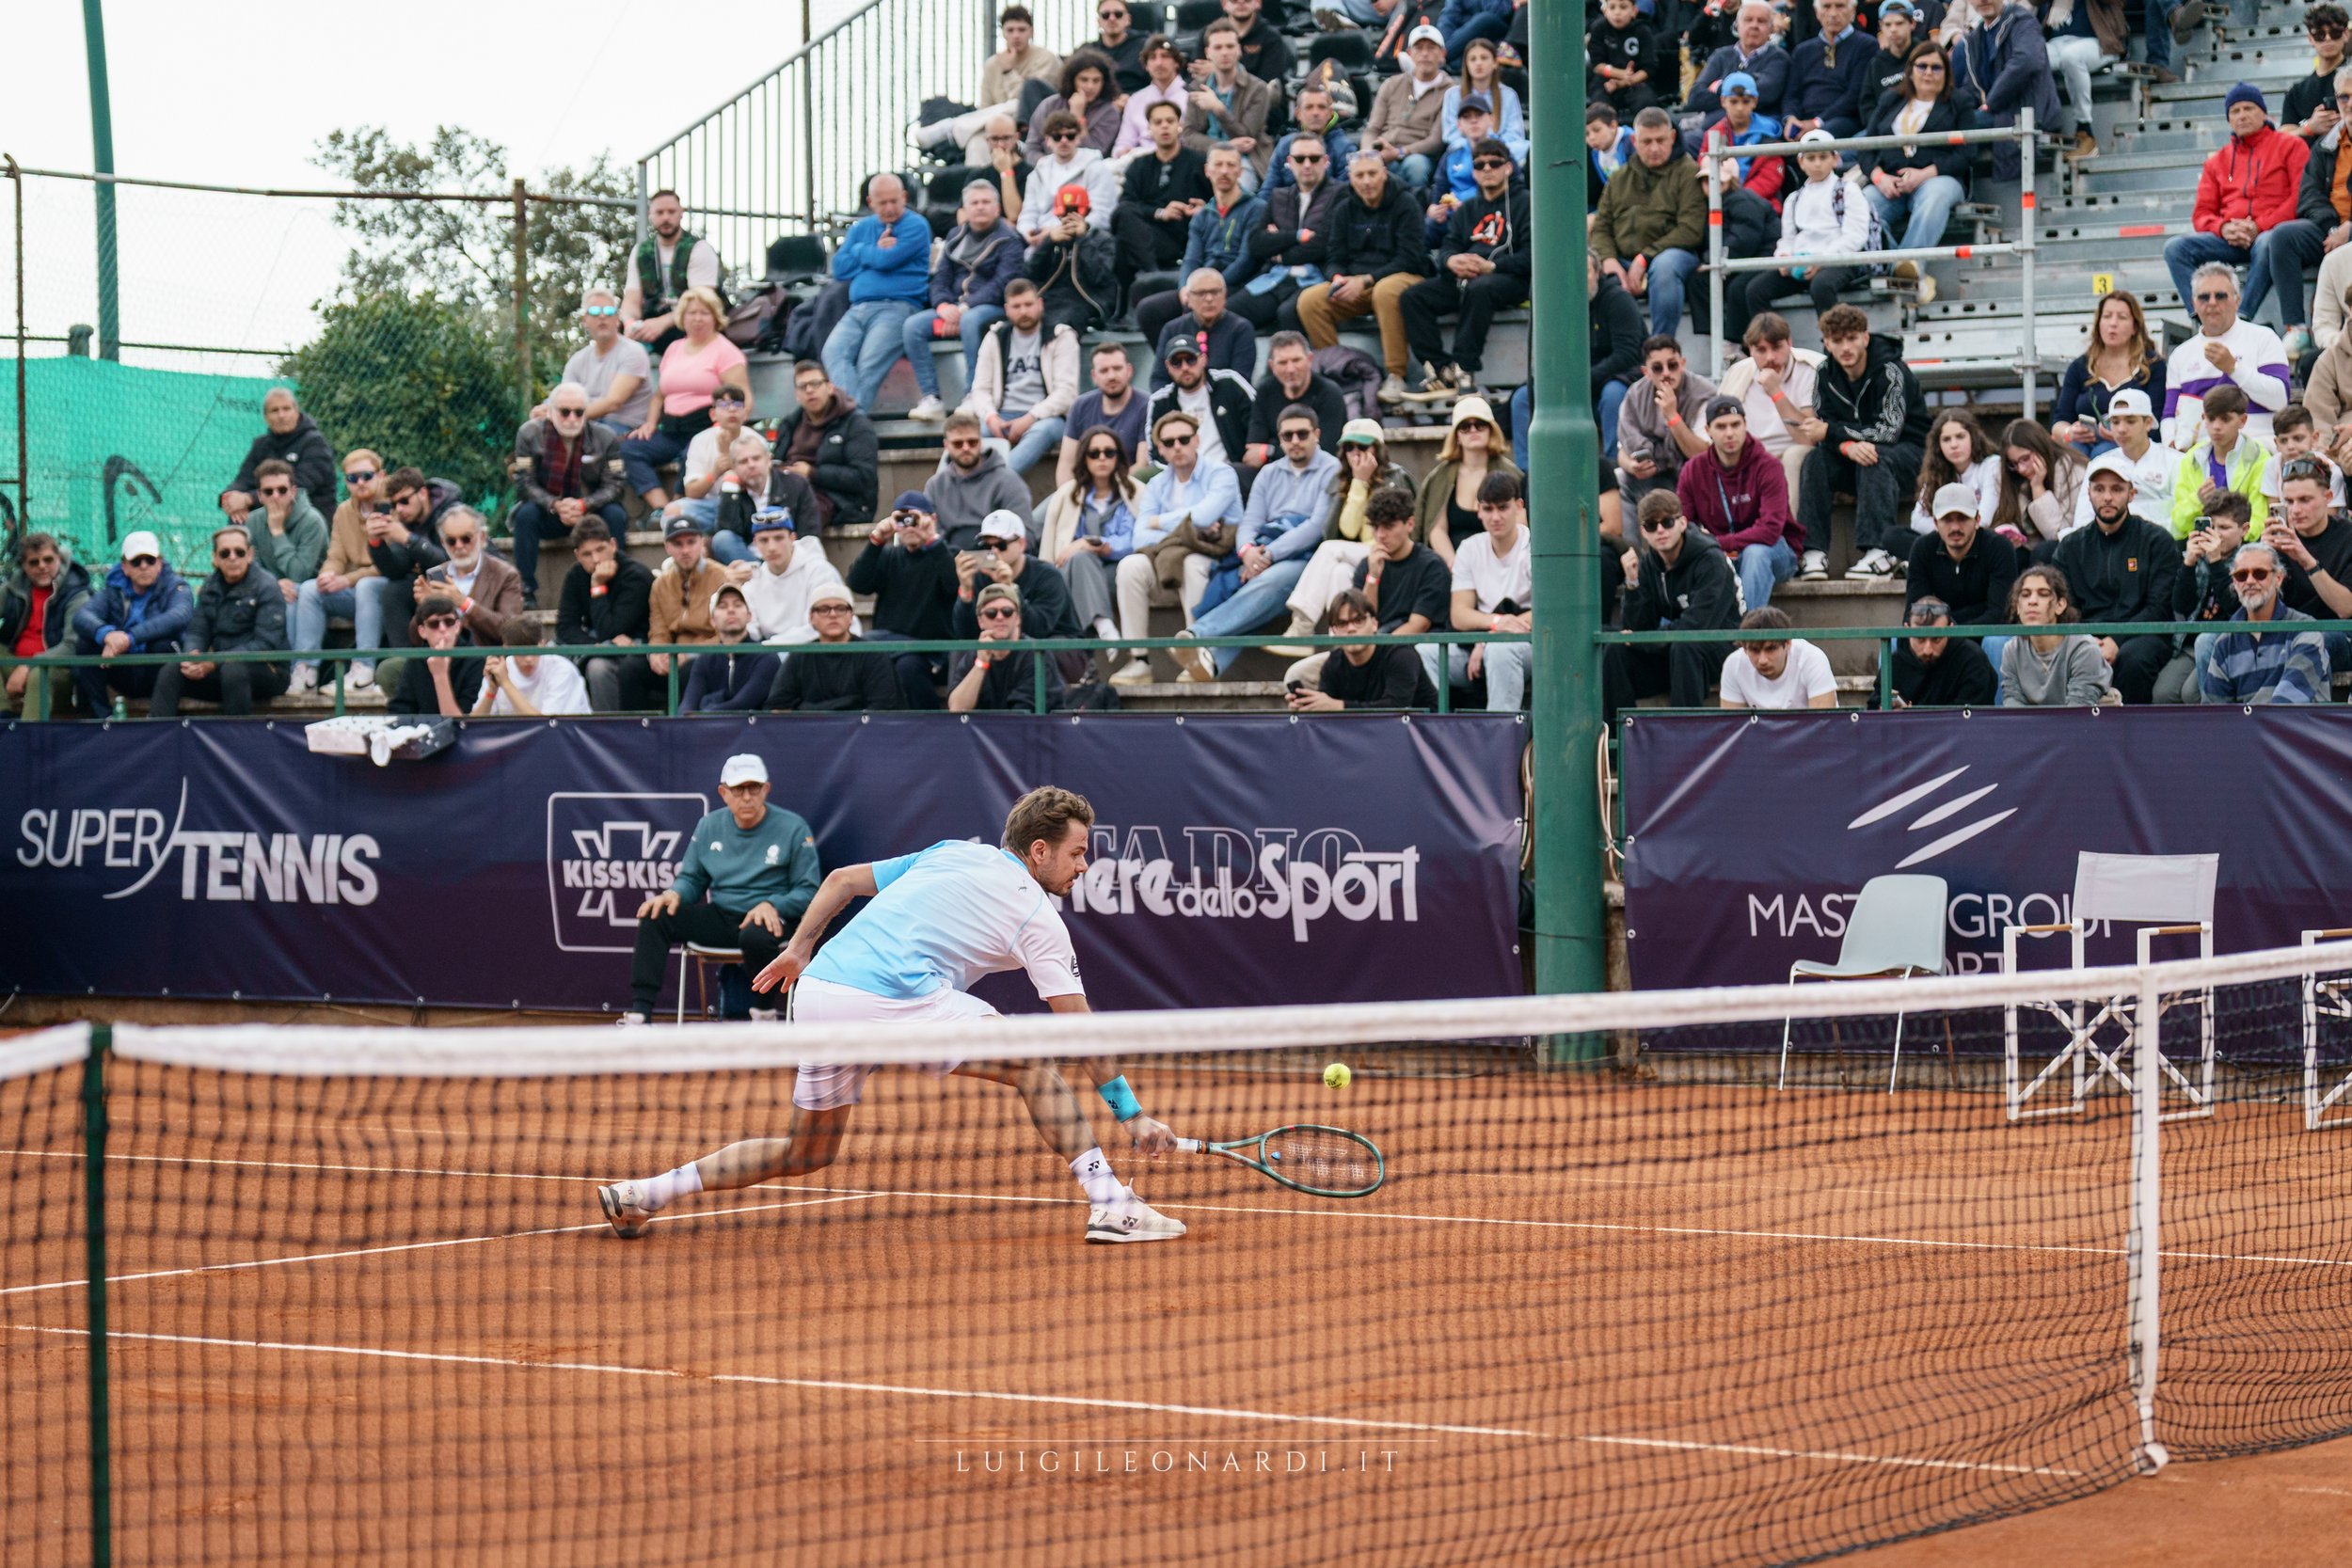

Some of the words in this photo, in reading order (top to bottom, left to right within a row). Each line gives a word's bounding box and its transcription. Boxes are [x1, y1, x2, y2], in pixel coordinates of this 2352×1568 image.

[1624, 37, 1639, 56] G
[2099, 277, 2106, 293] 3
[16, 808, 166, 867] SUPER
[172, 831, 382, 906] TENNIS
[1259, 843, 1420, 942] Sport
[1748, 893, 1861, 938] MAS
[1948, 893, 2111, 939] GROU
